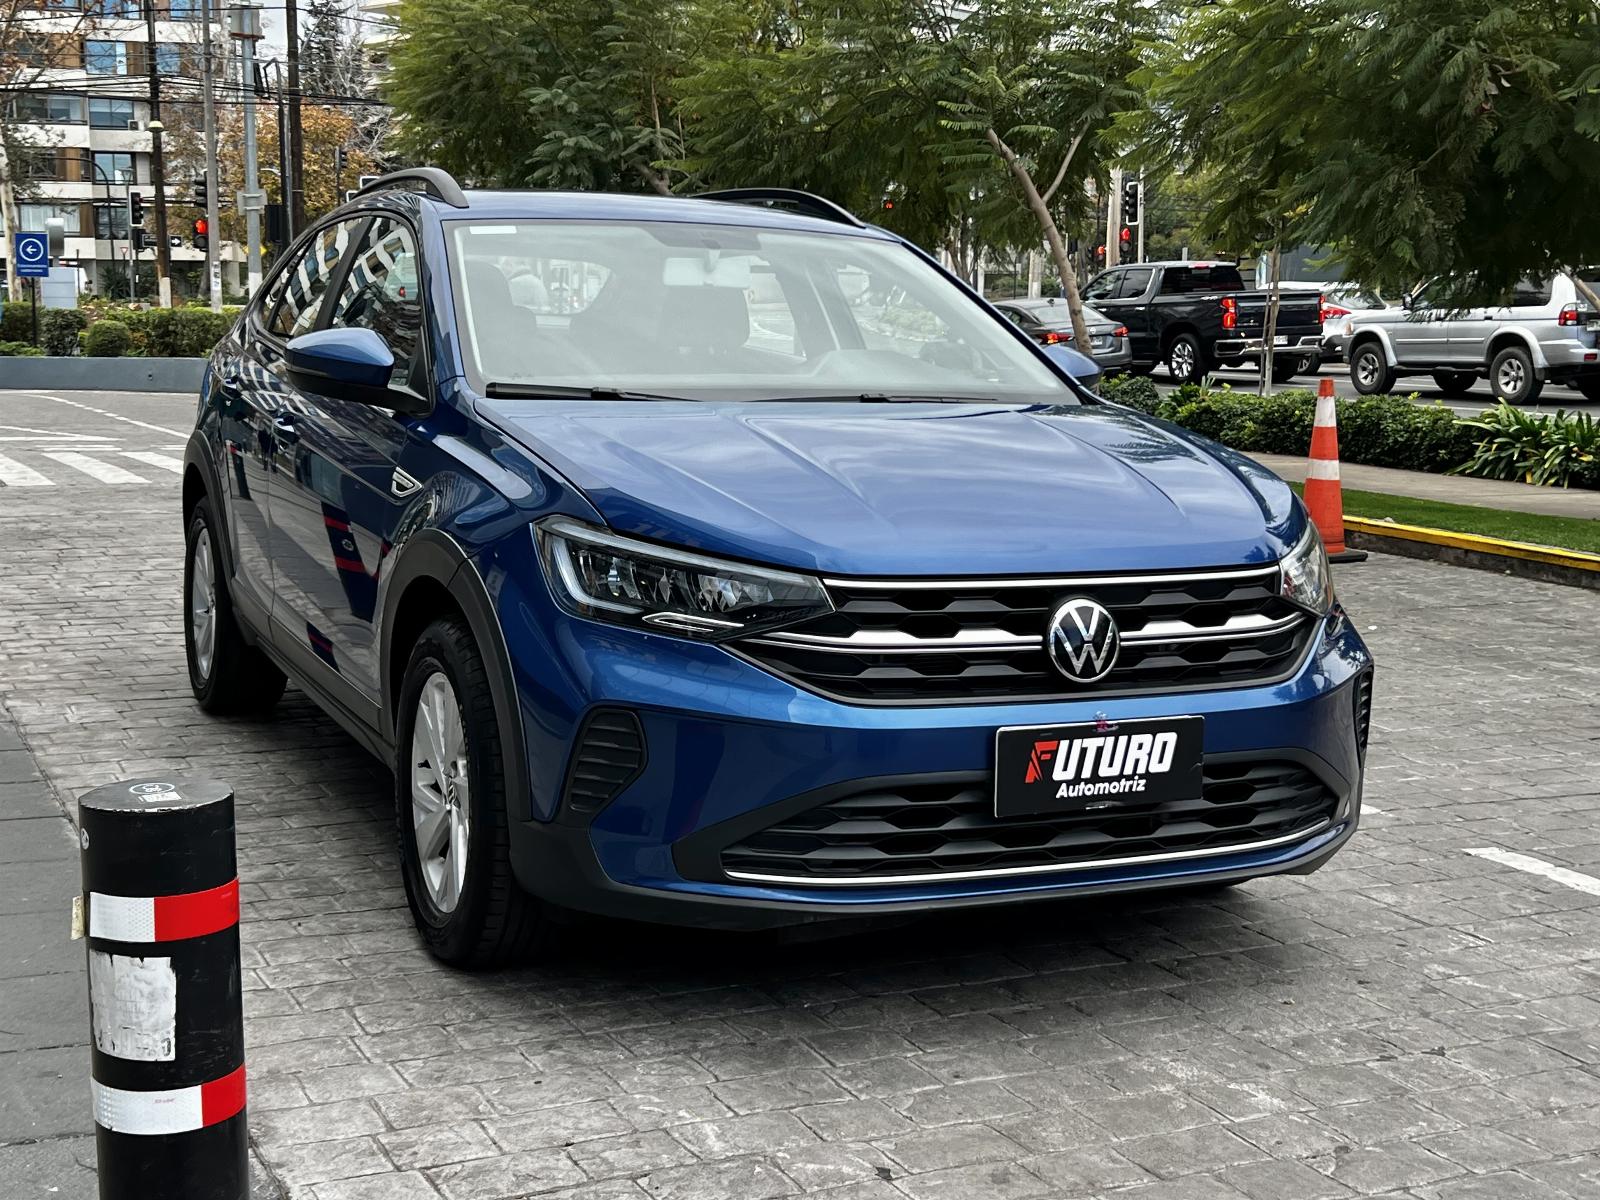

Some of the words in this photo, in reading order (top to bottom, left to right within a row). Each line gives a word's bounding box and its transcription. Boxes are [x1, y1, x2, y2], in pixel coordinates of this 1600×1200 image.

[1052, 602, 1116, 677] VW
[1024, 732, 1178, 783] FUTURO
[1055, 776, 1147, 799] Automotriz
